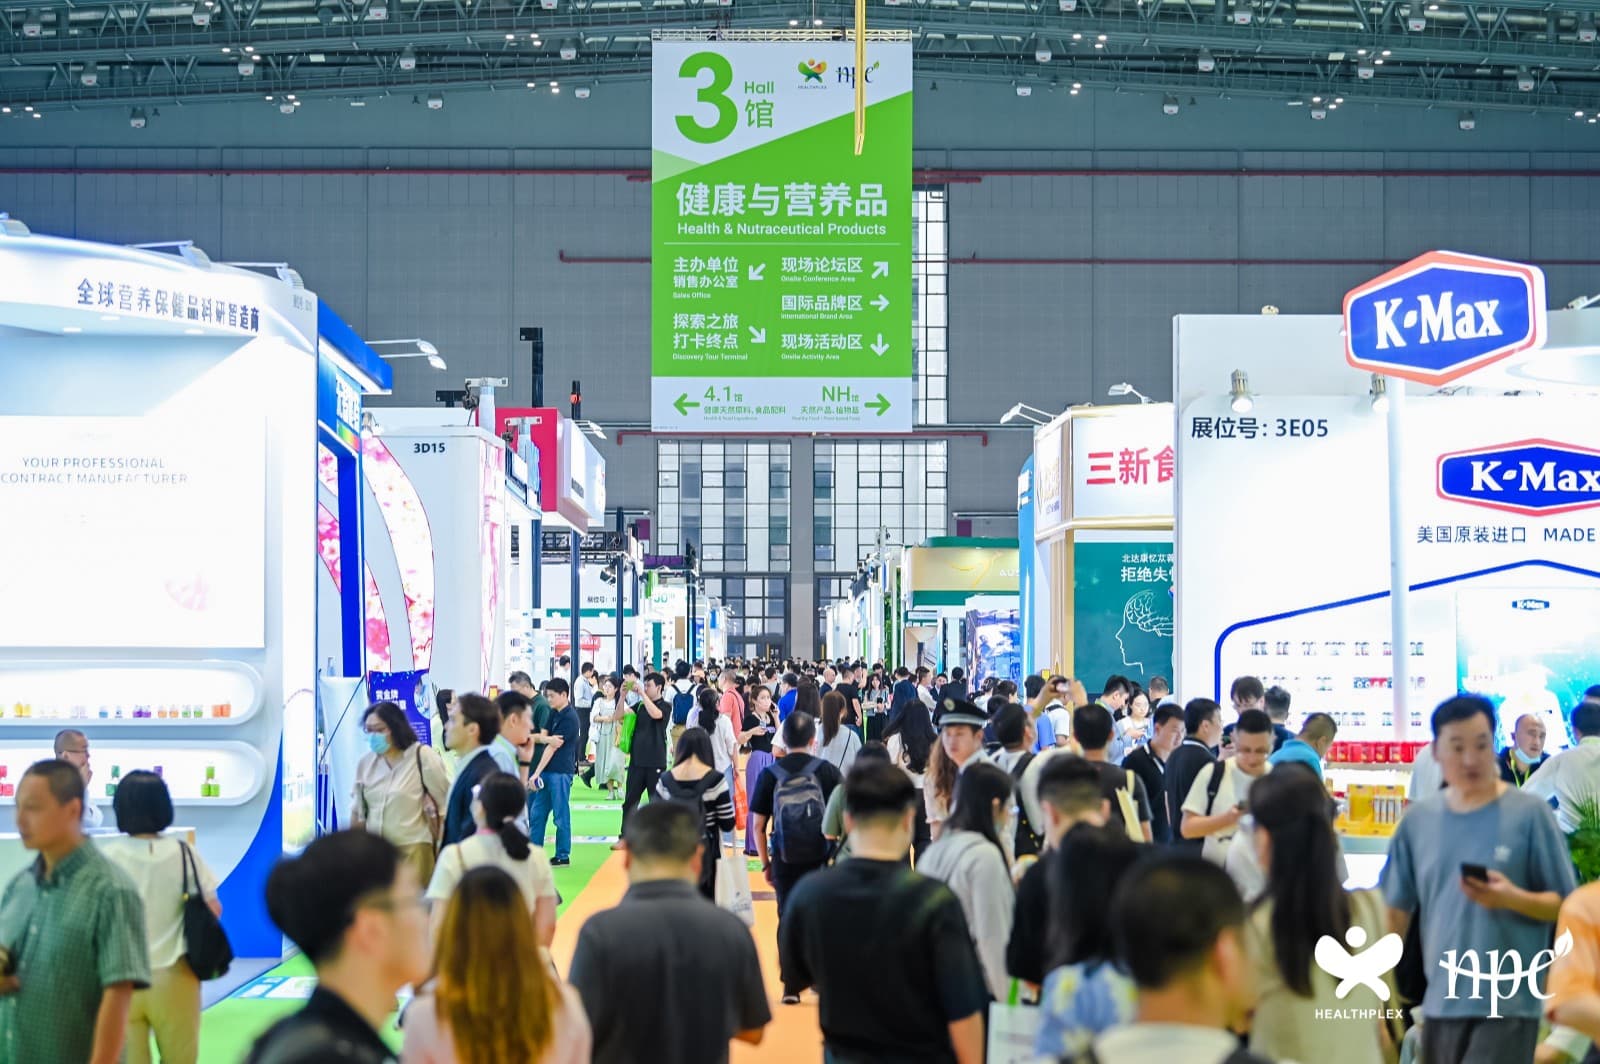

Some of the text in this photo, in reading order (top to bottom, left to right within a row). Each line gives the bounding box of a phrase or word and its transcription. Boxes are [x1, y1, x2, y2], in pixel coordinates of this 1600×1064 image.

[744, 80, 775, 94] Hall
[674, 51, 739, 144] 3
[744, 99, 774, 129] 馆
[676, 182, 888, 217] 健康与营养品
[677, 223, 887, 235] Health & Nutraceutical Products
[673, 256, 739, 273] 主办单位
[781, 256, 863, 273] 现场论坛区
[673, 275, 739, 289] 销售办公室
[77, 277, 260, 333] 全球营养保健品科研智造商
[781, 295, 863, 311] 国际品牌区
[673, 313, 739, 330] 探索之旅
[673, 333, 739, 349] 打卡终点
[781, 334, 863, 350] 现场活动区
[672, 353, 704, 361] Discovery
[1275, 418, 1328, 438] 3E05
[413, 442, 446, 454] 3D15
[22, 457, 166, 469] YOUR PROFESSIONAL
[0, 472, 72, 484] CONTRACT
[1416, 526, 1597, 544] 美国原装进口 MADE
